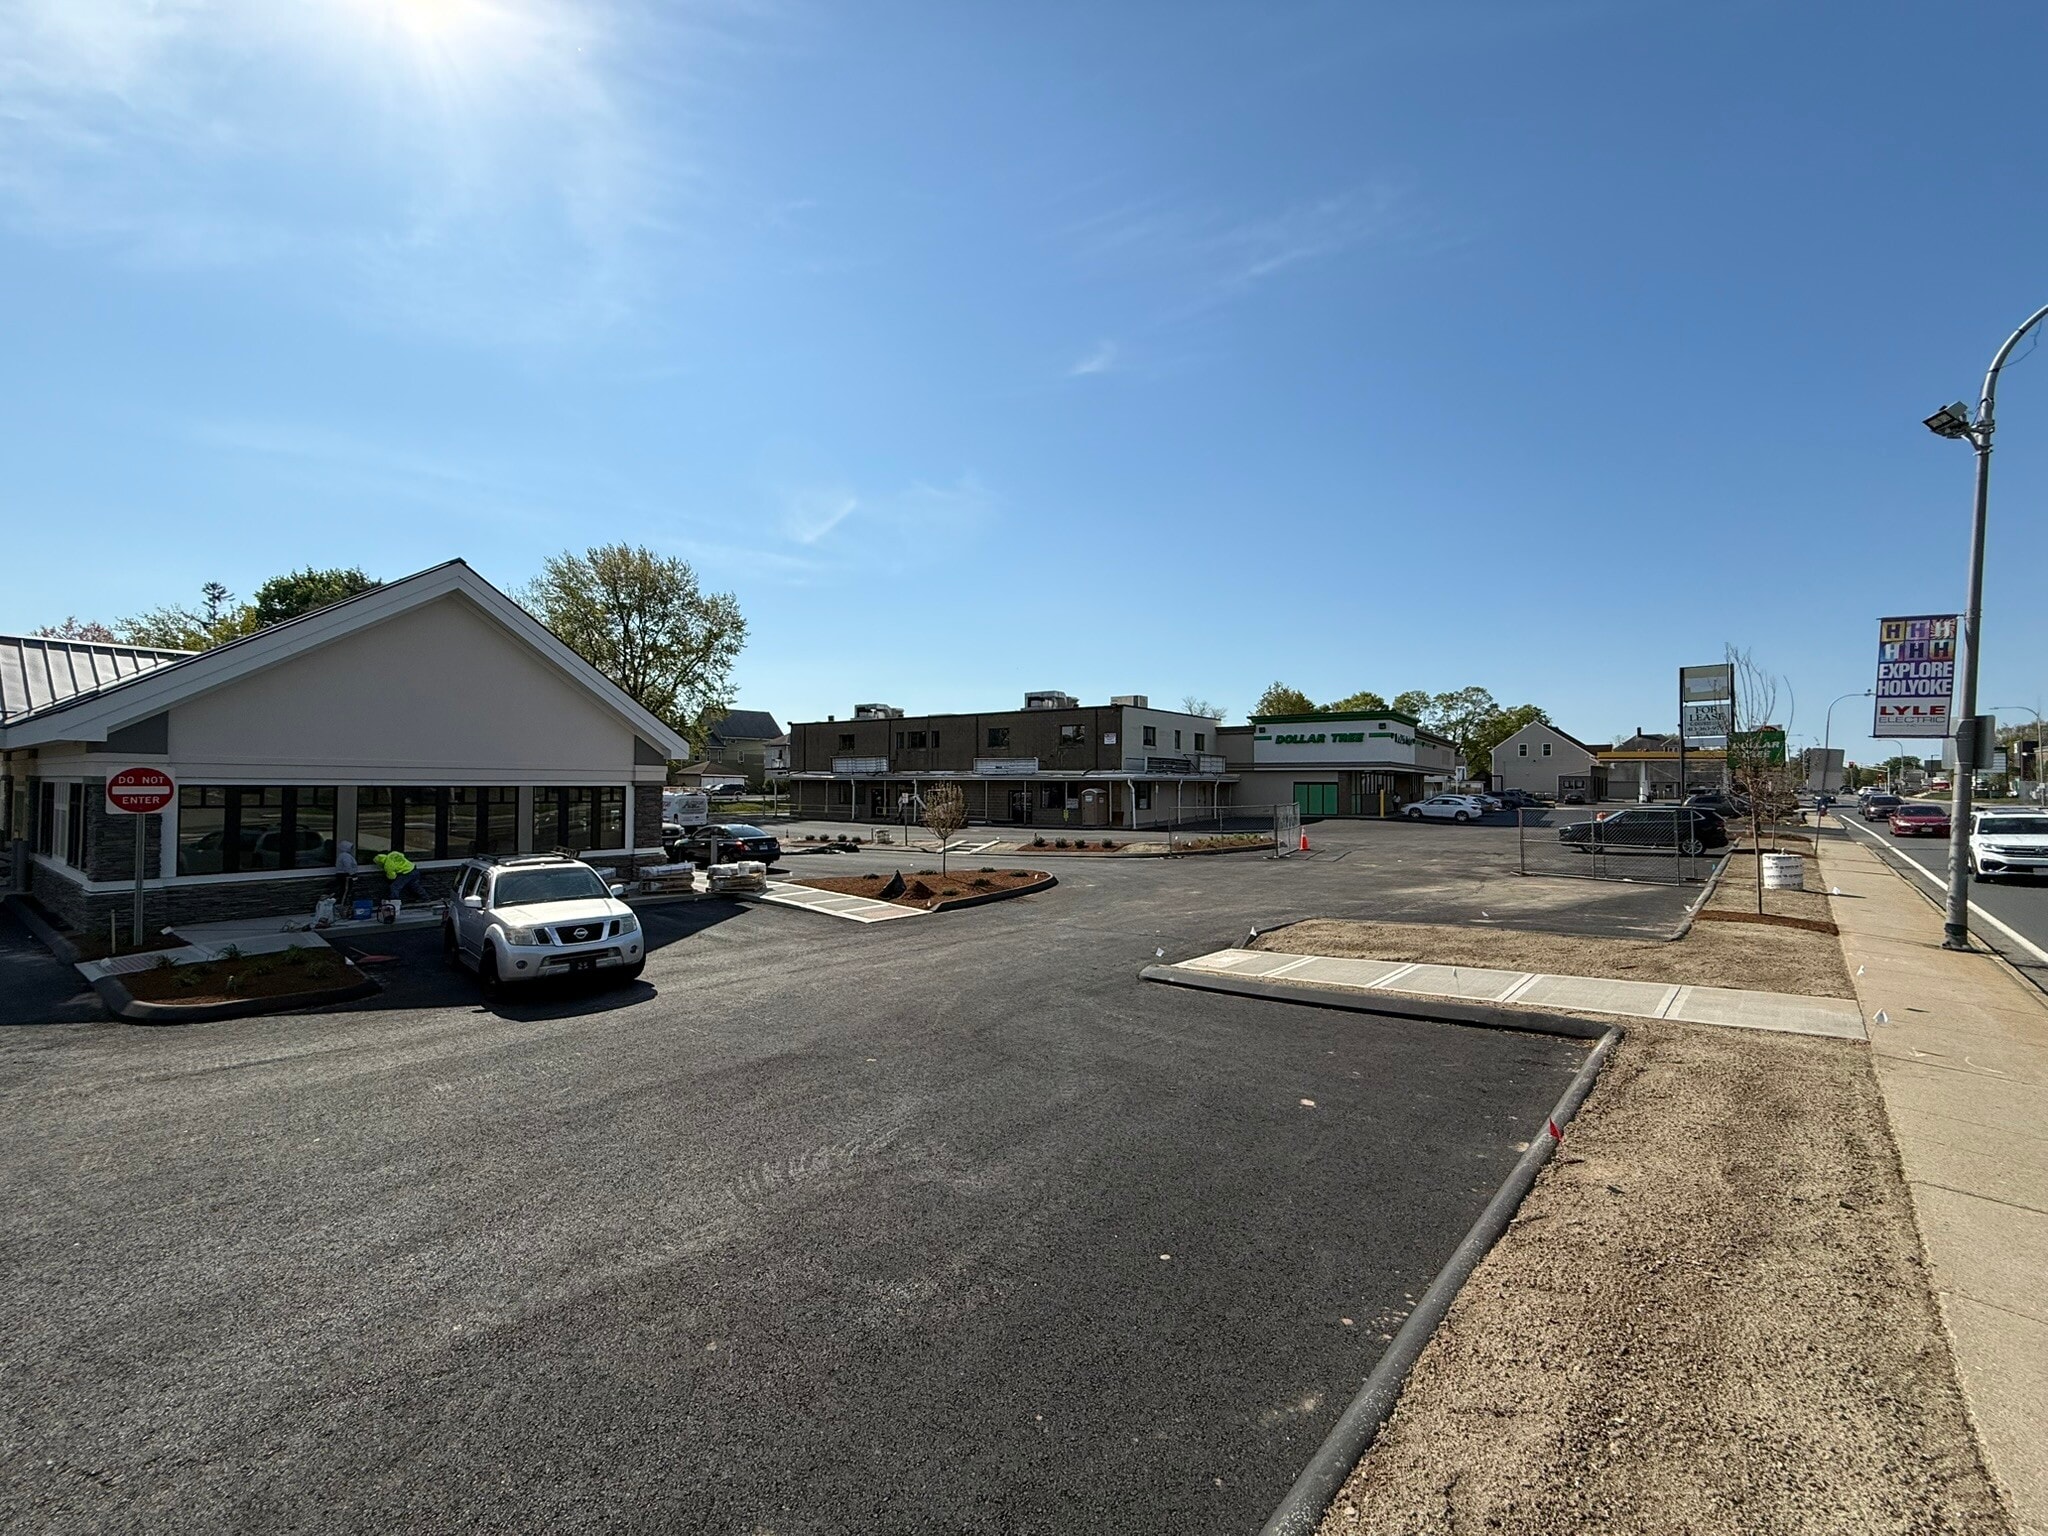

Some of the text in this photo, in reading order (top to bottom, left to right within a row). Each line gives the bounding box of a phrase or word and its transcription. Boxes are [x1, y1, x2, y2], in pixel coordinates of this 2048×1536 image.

[1886, 620, 1950, 639] H H H
[1885, 641, 1949, 659] H H H
[1878, 661, 1953, 679] EXPLORE
[1877, 678, 1953, 696] HOLYOKE
[1695, 705, 1718, 714] FOR
[1880, 705, 1946, 716] LYLE
[1689, 713, 1725, 722] LEASE
[1878, 716, 1946, 724] ELECTRIC
[1275, 732, 1365, 744] DOLLAR TREE
[118, 776, 165, 784] DO NOT
[122, 796, 160, 804] ENTER
